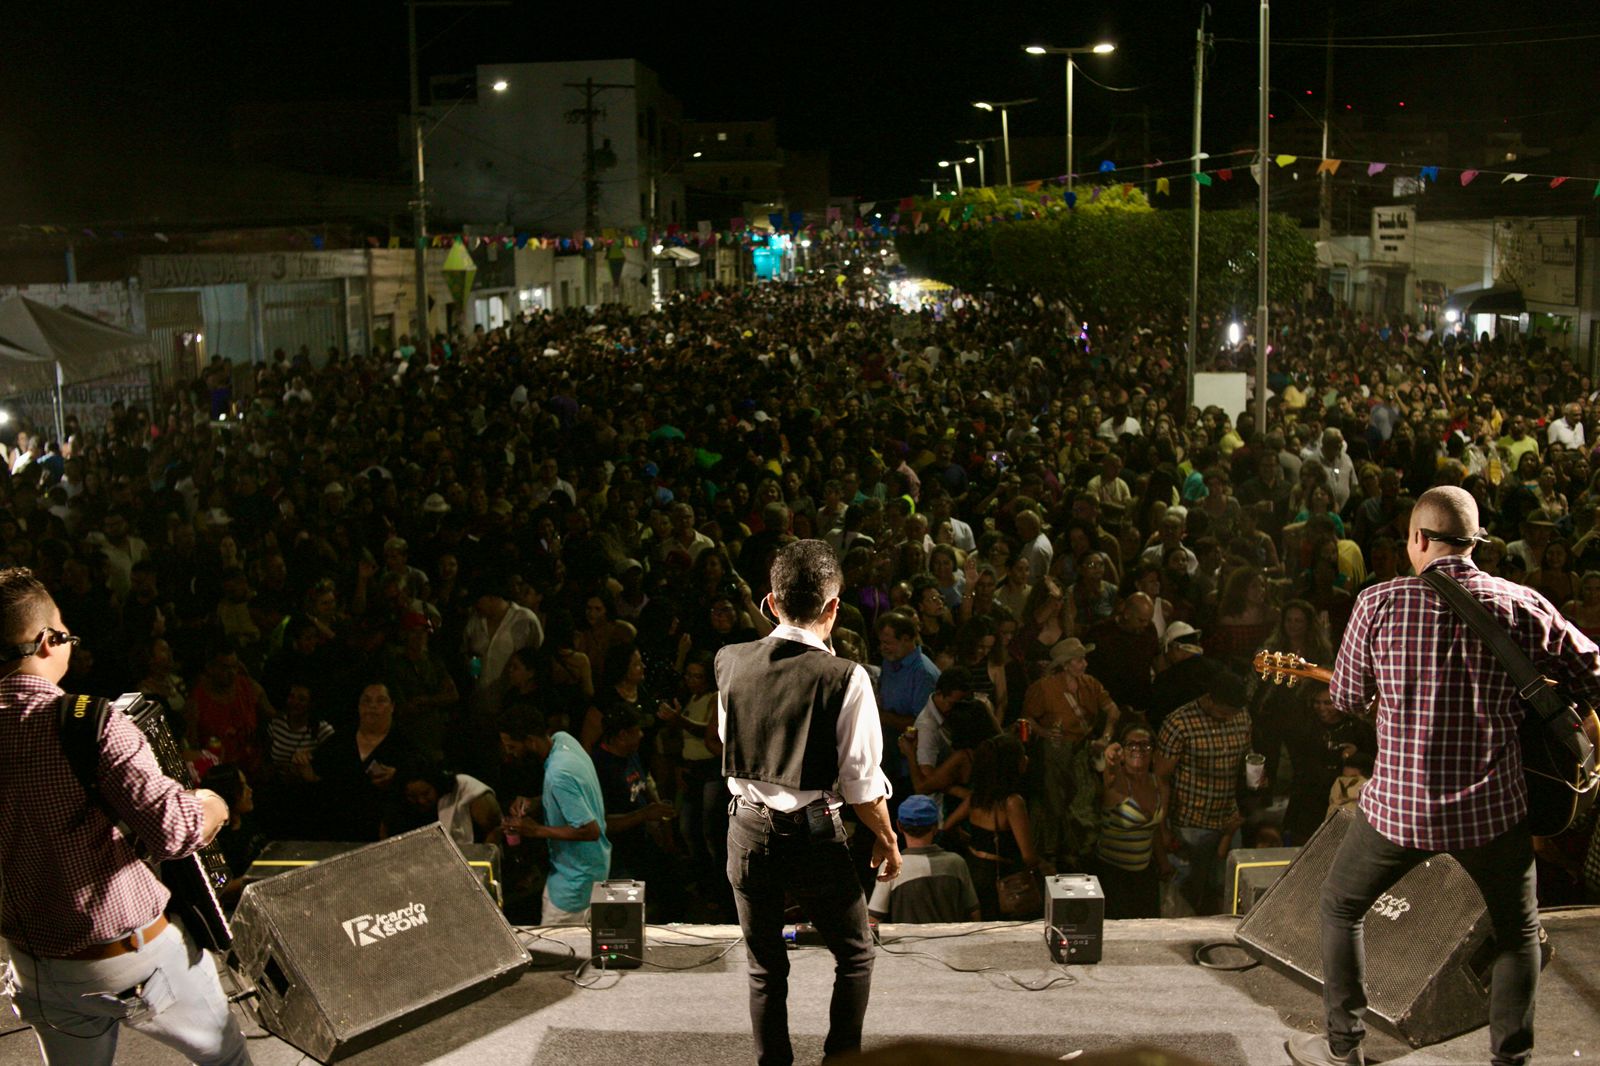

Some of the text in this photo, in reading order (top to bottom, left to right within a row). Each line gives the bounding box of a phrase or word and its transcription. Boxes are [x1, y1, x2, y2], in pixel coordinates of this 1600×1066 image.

[149, 255, 207, 288] LAVA
[270, 253, 288, 281] 3
[341, 902, 426, 947] Ricardo
[383, 912, 429, 937] SOM
[1371, 900, 1403, 921] OM
